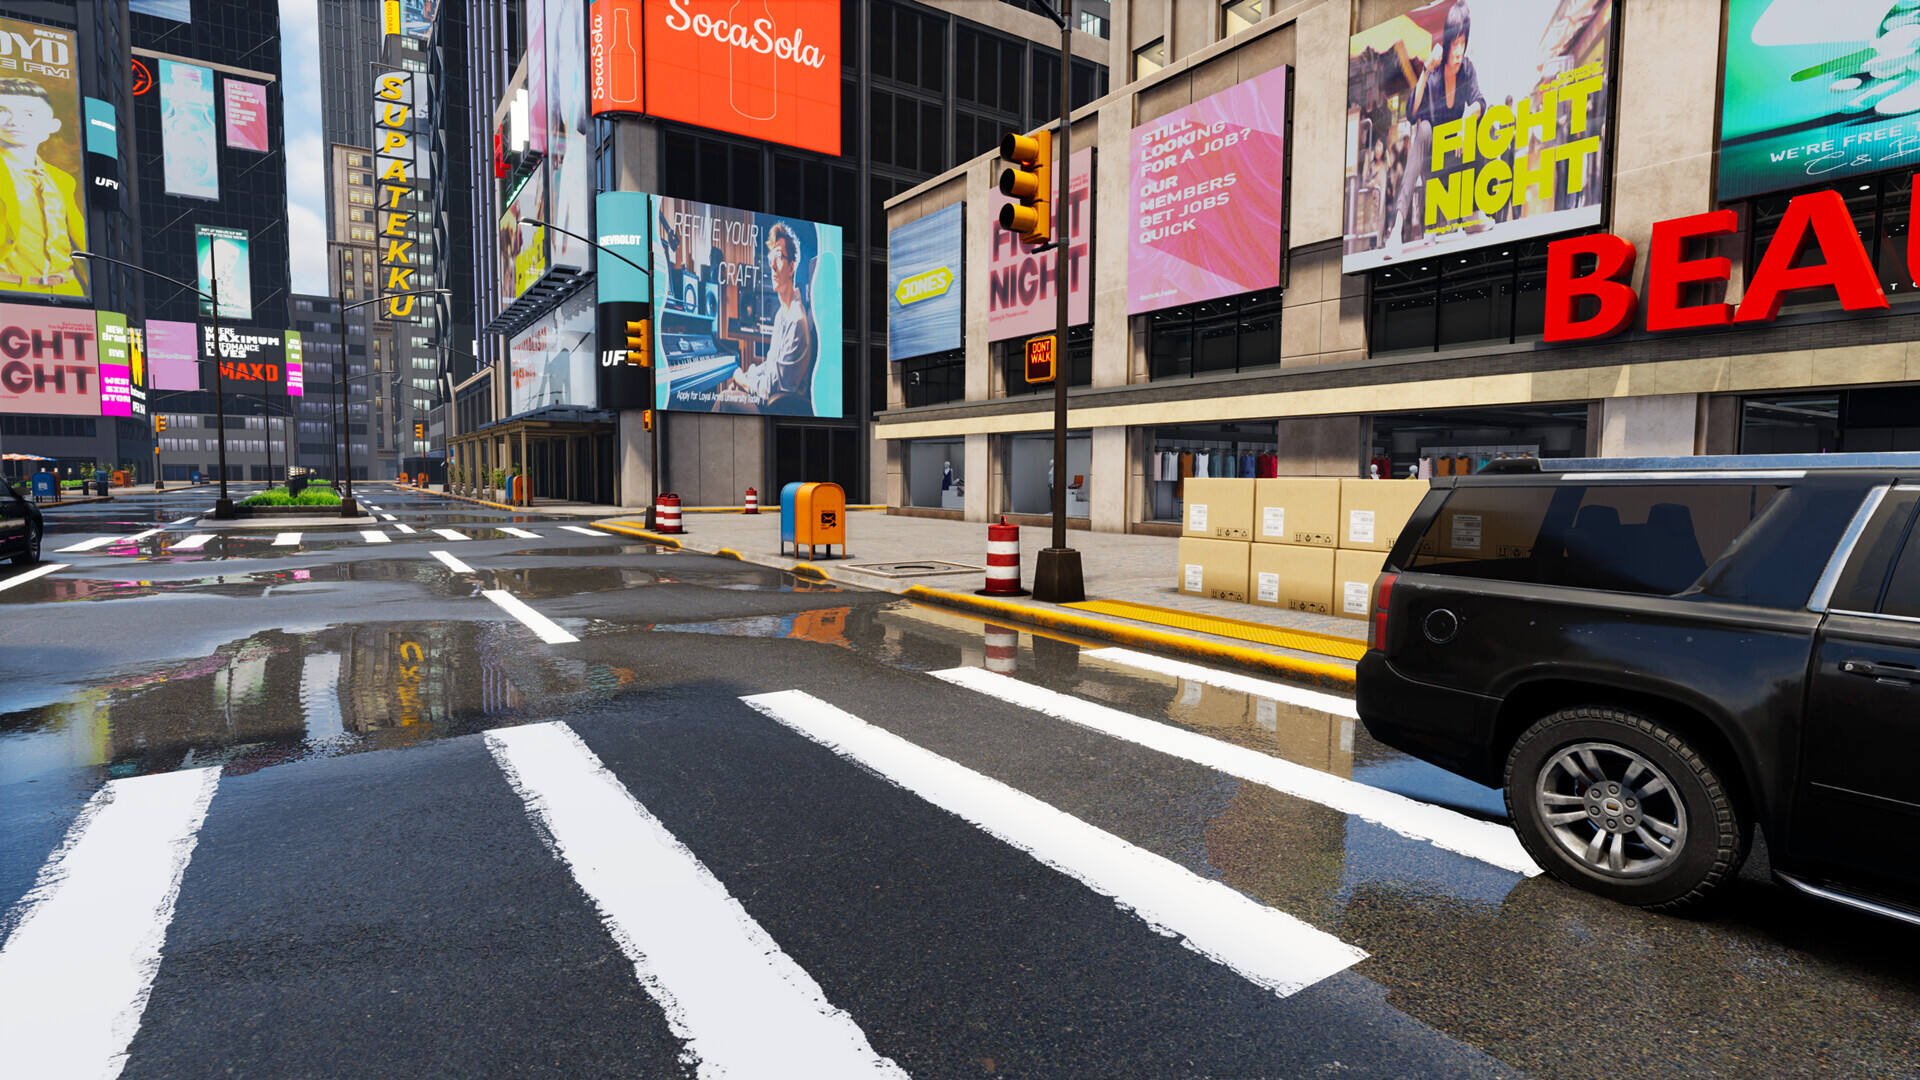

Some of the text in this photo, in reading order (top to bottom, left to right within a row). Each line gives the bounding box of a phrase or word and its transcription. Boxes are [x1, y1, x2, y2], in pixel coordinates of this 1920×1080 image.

[665, 0, 825, 68] SocaSola
[591, 14, 604, 100] SocaSola
[1140, 118, 1193, 147] STILL
[1140, 120, 1226, 162] LOOKING
[1431, 76, 1603, 173] FIGHT
[1140, 128, 1252, 178] FOR A JOB?
[1770, 139, 1835, 163] WE'RE
[1843, 124, 1903, 147] FREE
[380, 77, 415, 317] SUPATEKKU
[1140, 175, 1179, 198] OUR
[1140, 172, 1238, 214] MEMBERS
[1424, 135, 1600, 226] NIGHT
[1178, 191, 1231, 218] JOBS
[673, 212, 760, 248] REFINE YOUR
[993, 186, 1089, 262] FIT
[1139, 218, 1197, 245] QUICK
[1544, 173, 1920, 342] BEA
[901, 272, 947, 299] JONES
[989, 243, 1088, 312] NIGHT
[0, 325, 95, 361] GHT
[204, 326, 235, 337] WERE
[205, 333, 280, 346] MAXIMUM
[206, 341, 260, 352] PEFOMANCE
[1032, 341, 1050, 354] DONT
[206, 349, 248, 359] LVES
[602, 349, 642, 367] UF
[1031, 351, 1051, 364] WALK
[1, 360, 97, 395] GHT
